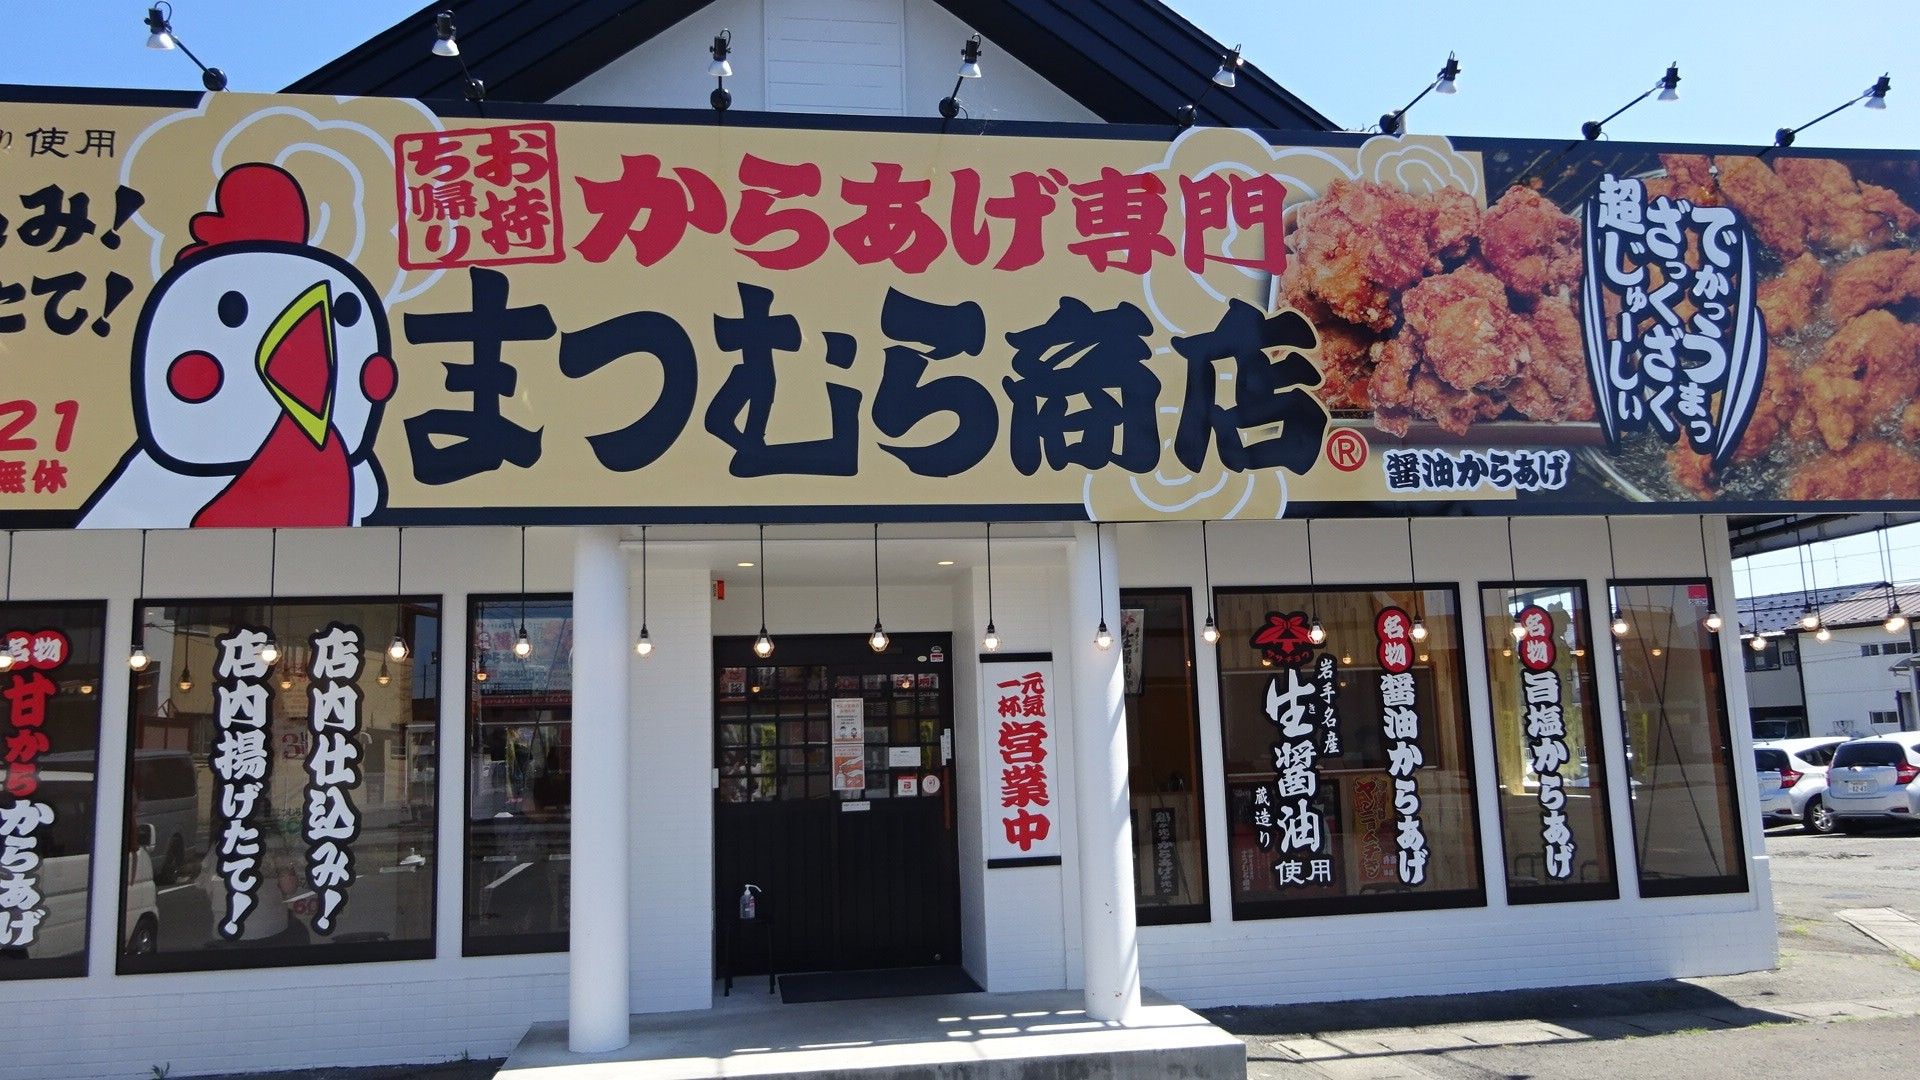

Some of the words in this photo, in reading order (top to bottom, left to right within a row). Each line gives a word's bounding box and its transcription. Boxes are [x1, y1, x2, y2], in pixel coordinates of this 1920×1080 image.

[25, 127, 116, 158] 使用
[0, 183, 145, 252] み!
[573, 152, 1289, 275] からあげ専門
[403, 266, 1331, 485] まつむら商店
[0, 459, 68, 494] 無休
[1386, 452, 1567, 489] 醤油からあげ
[1382, 614, 1407, 666] 名物
[1525, 612, 1549, 664] 名物
[1317, 657, 1340, 755] 岩手名産
[214, 628, 271, 937] 店内揚げたて!
[308, 627, 360, 931] 店内仕込み!
[998, 720, 1051, 852] 営業中
[1380, 671, 1428, 884] 醤油からあげ
[1524, 670, 1575, 878] 旨塩からあげ
[1254, 786, 1273, 848] 蔵造り
[1275, 859, 1332, 886] 使用
